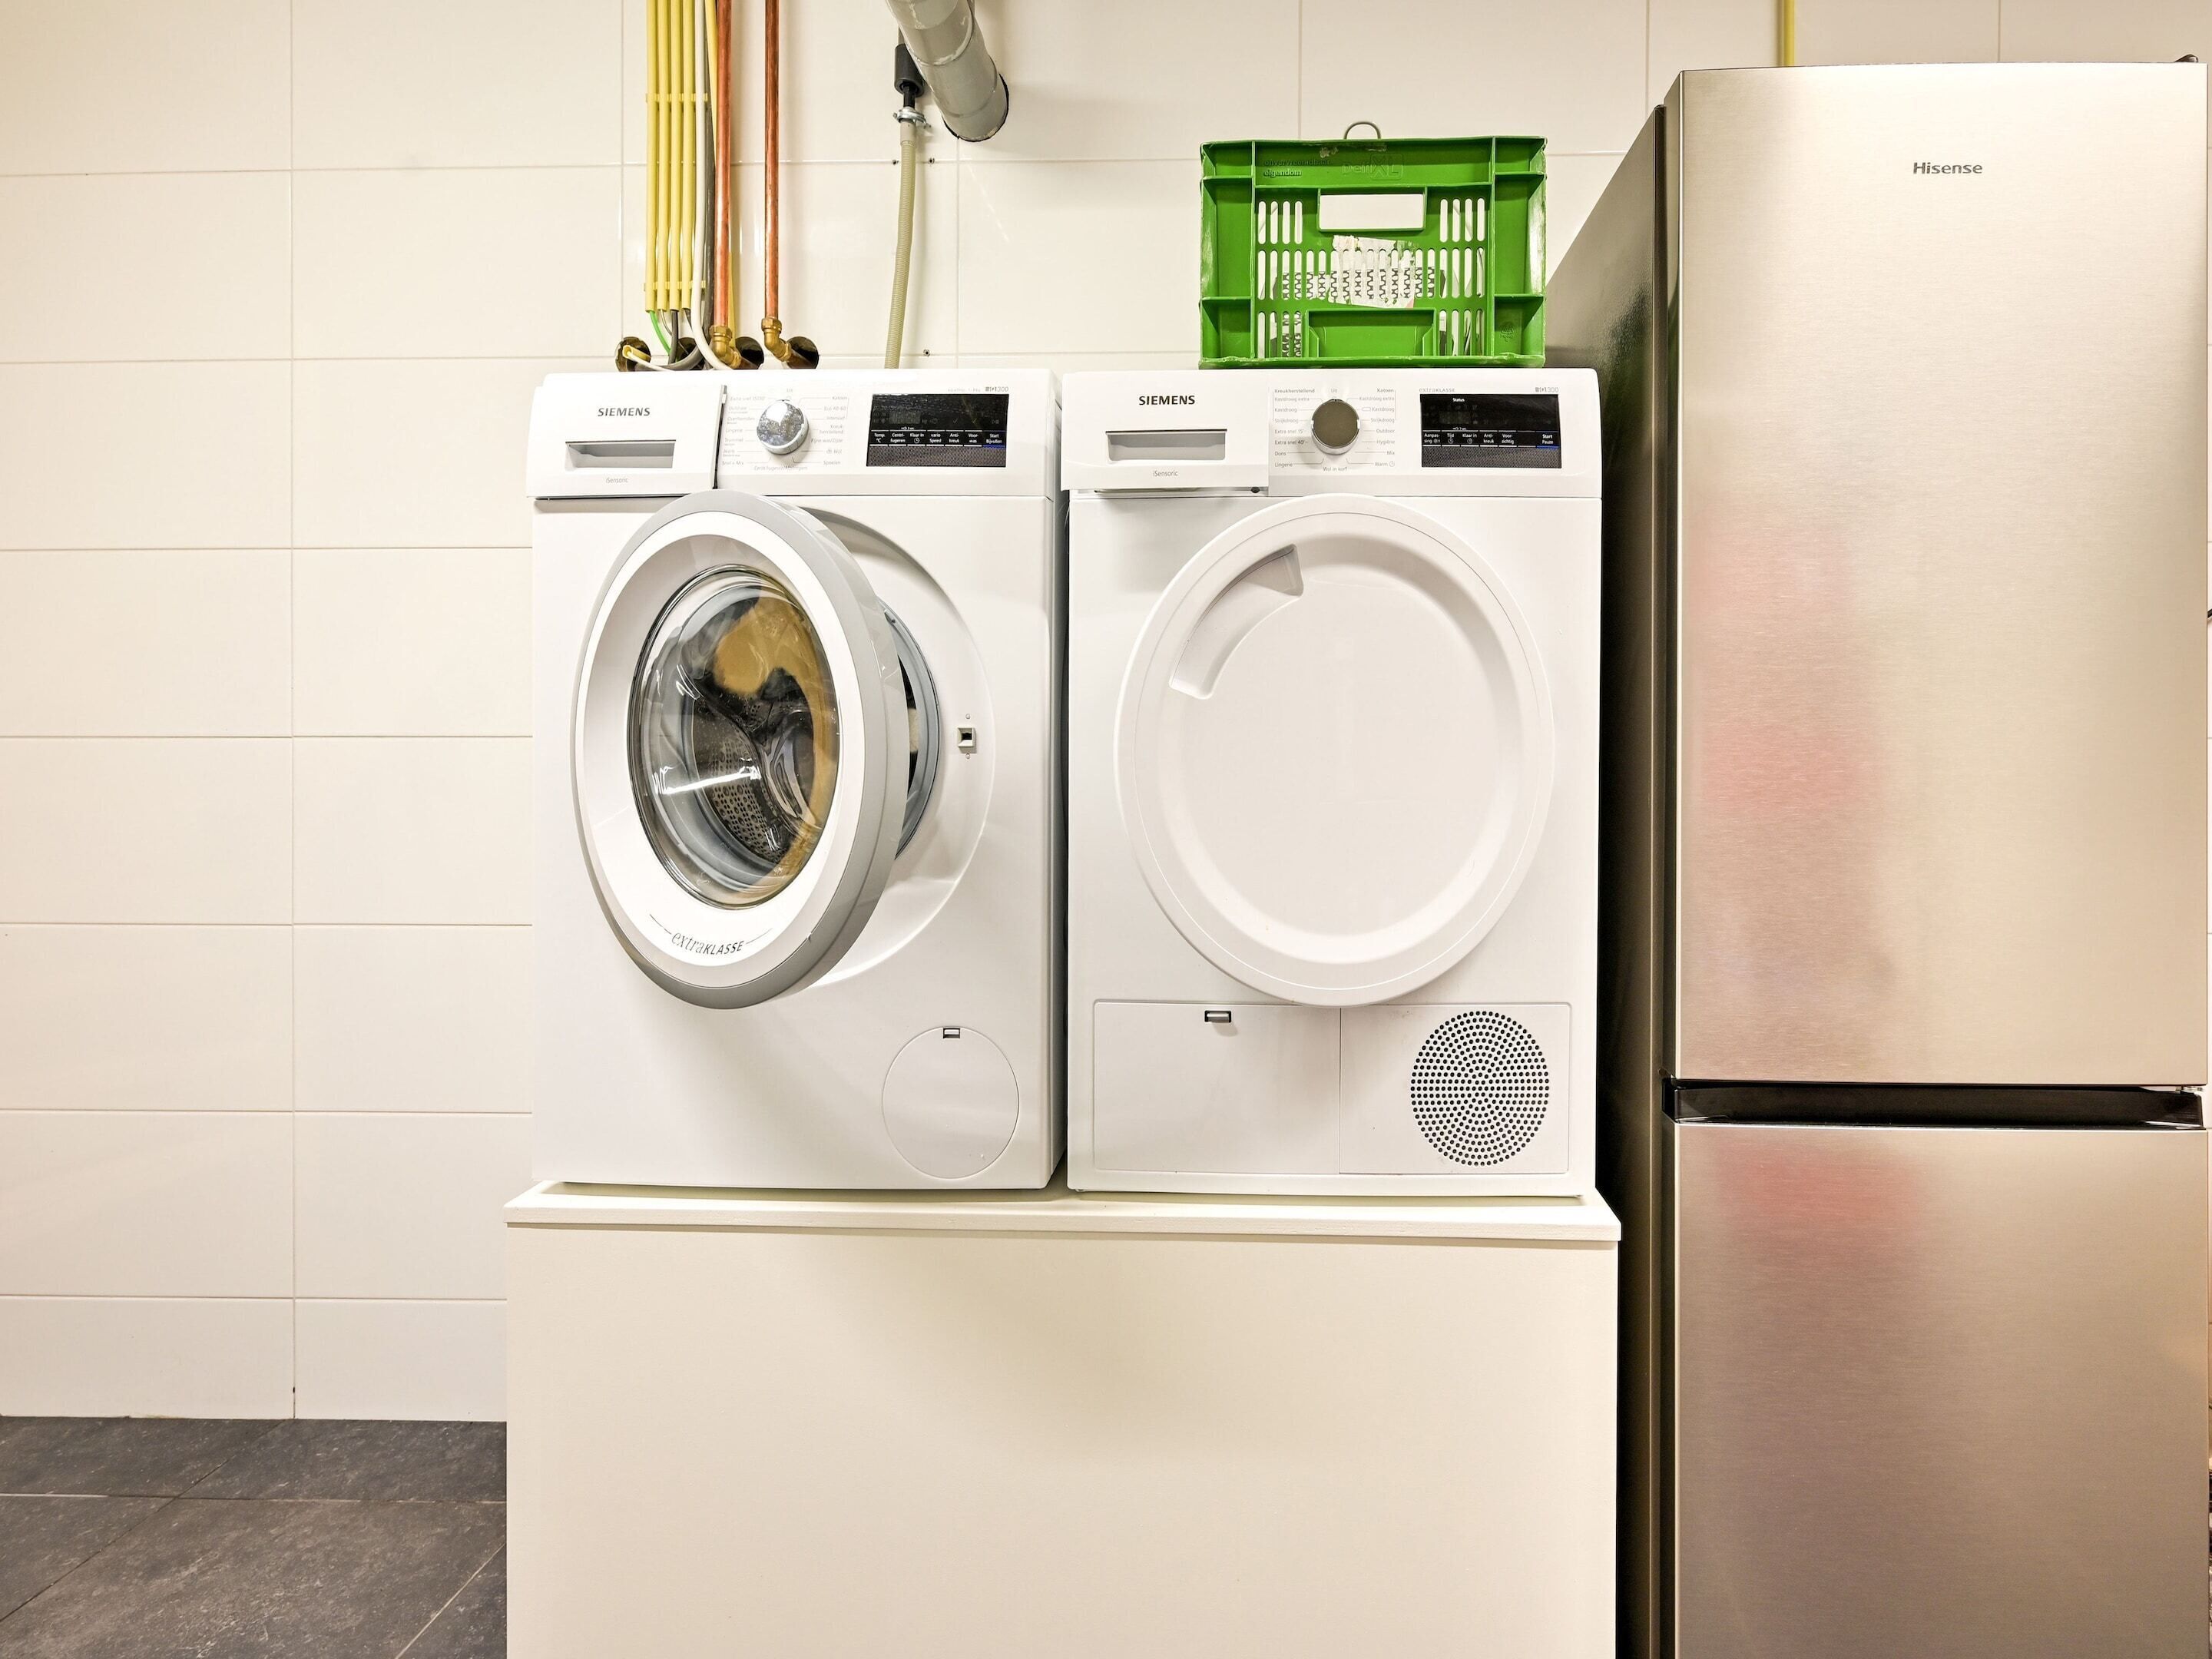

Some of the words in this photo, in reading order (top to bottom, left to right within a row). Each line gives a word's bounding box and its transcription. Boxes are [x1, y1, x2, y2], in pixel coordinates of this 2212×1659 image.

[1913, 162, 1982, 174] Hisense
[1139, 395, 1196, 406] SIEMENS
[598, 407, 651, 417] SIEMENS
[672, 932, 744, 955] extraKLASSE
